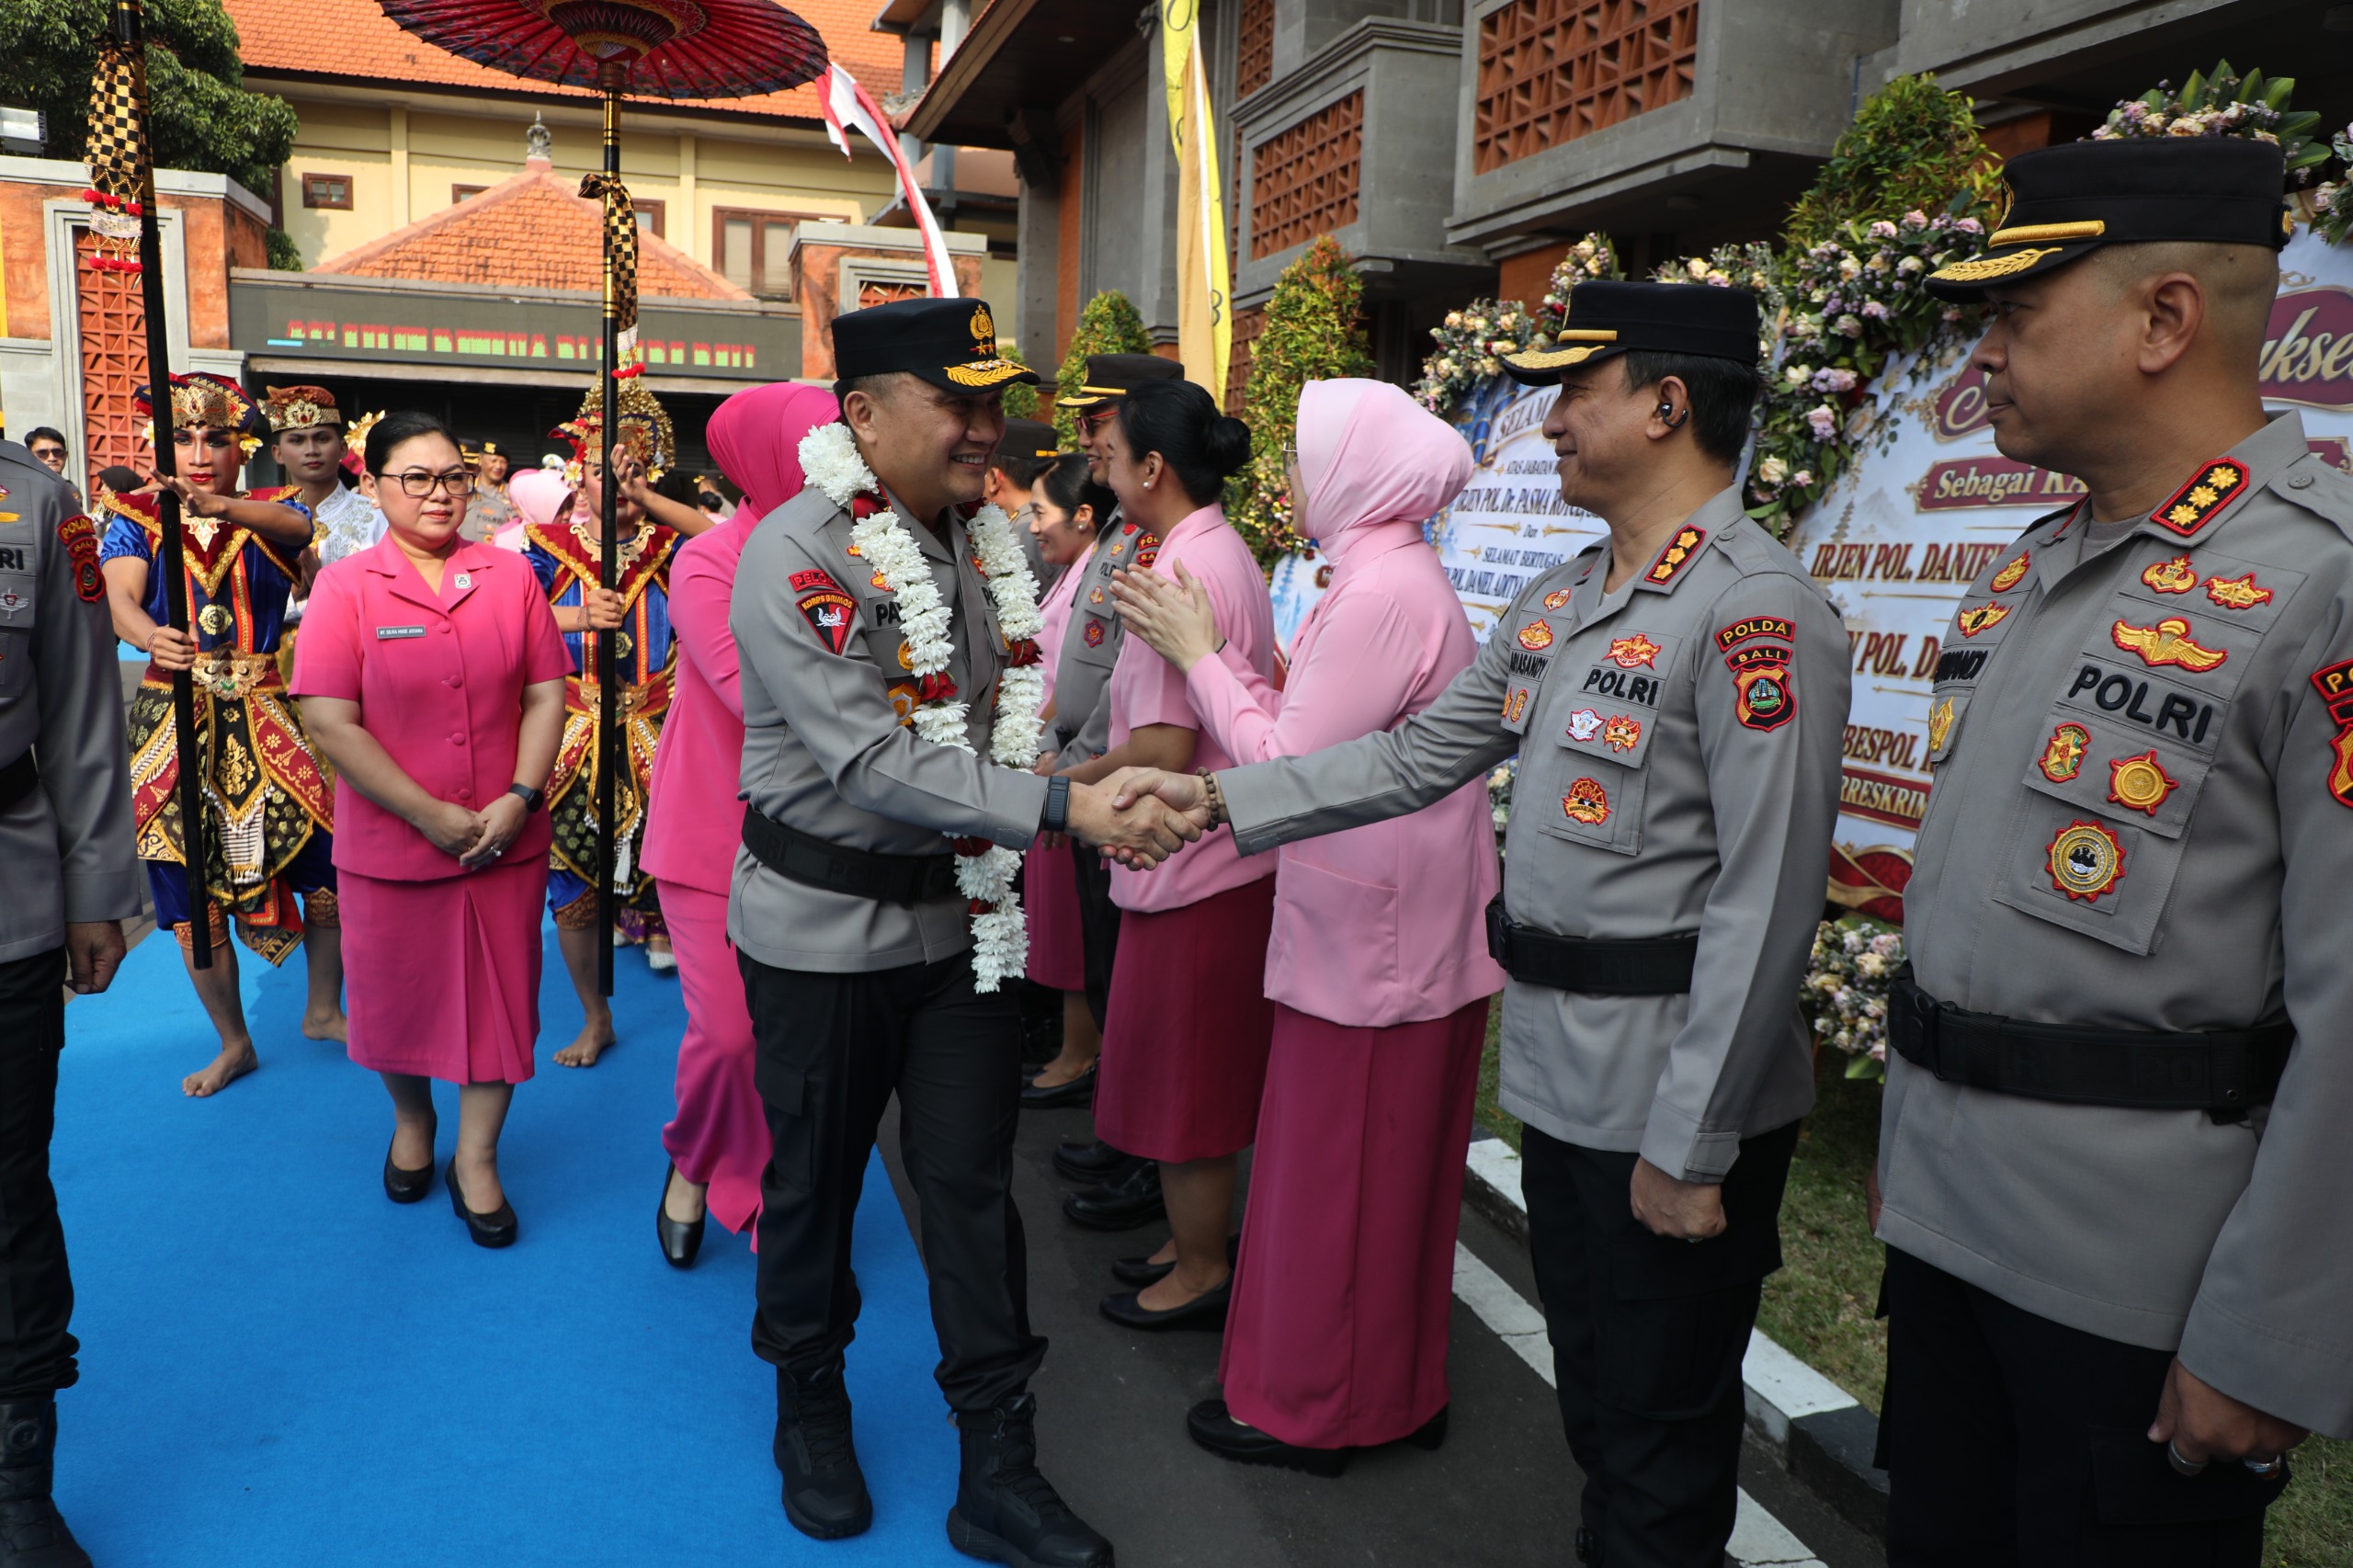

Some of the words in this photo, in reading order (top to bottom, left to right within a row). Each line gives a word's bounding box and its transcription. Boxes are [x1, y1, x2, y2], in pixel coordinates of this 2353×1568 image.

[1934, 465, 2036, 502] Sebagai
[1140, 536, 1159, 547] POL
[0, 548, 24, 570] RI
[1483, 547, 1520, 565] SELAMAT
[1519, 551, 1563, 569] BERTUGAS
[1810, 542, 1873, 579] IRJEN
[1869, 542, 1914, 582] POL.
[801, 596, 824, 610] KORPS
[825, 595, 853, 608] BRIMOB
[875, 600, 902, 627] PA
[1722, 620, 1787, 643] POLDA
[1738, 649, 1780, 663] BALI
[1856, 632, 1908, 678] POL.
[1583, 668, 1658, 706] POLRI
[2068, 665, 2212, 744] POLRI
[1842, 724, 1919, 769] BESPOL
